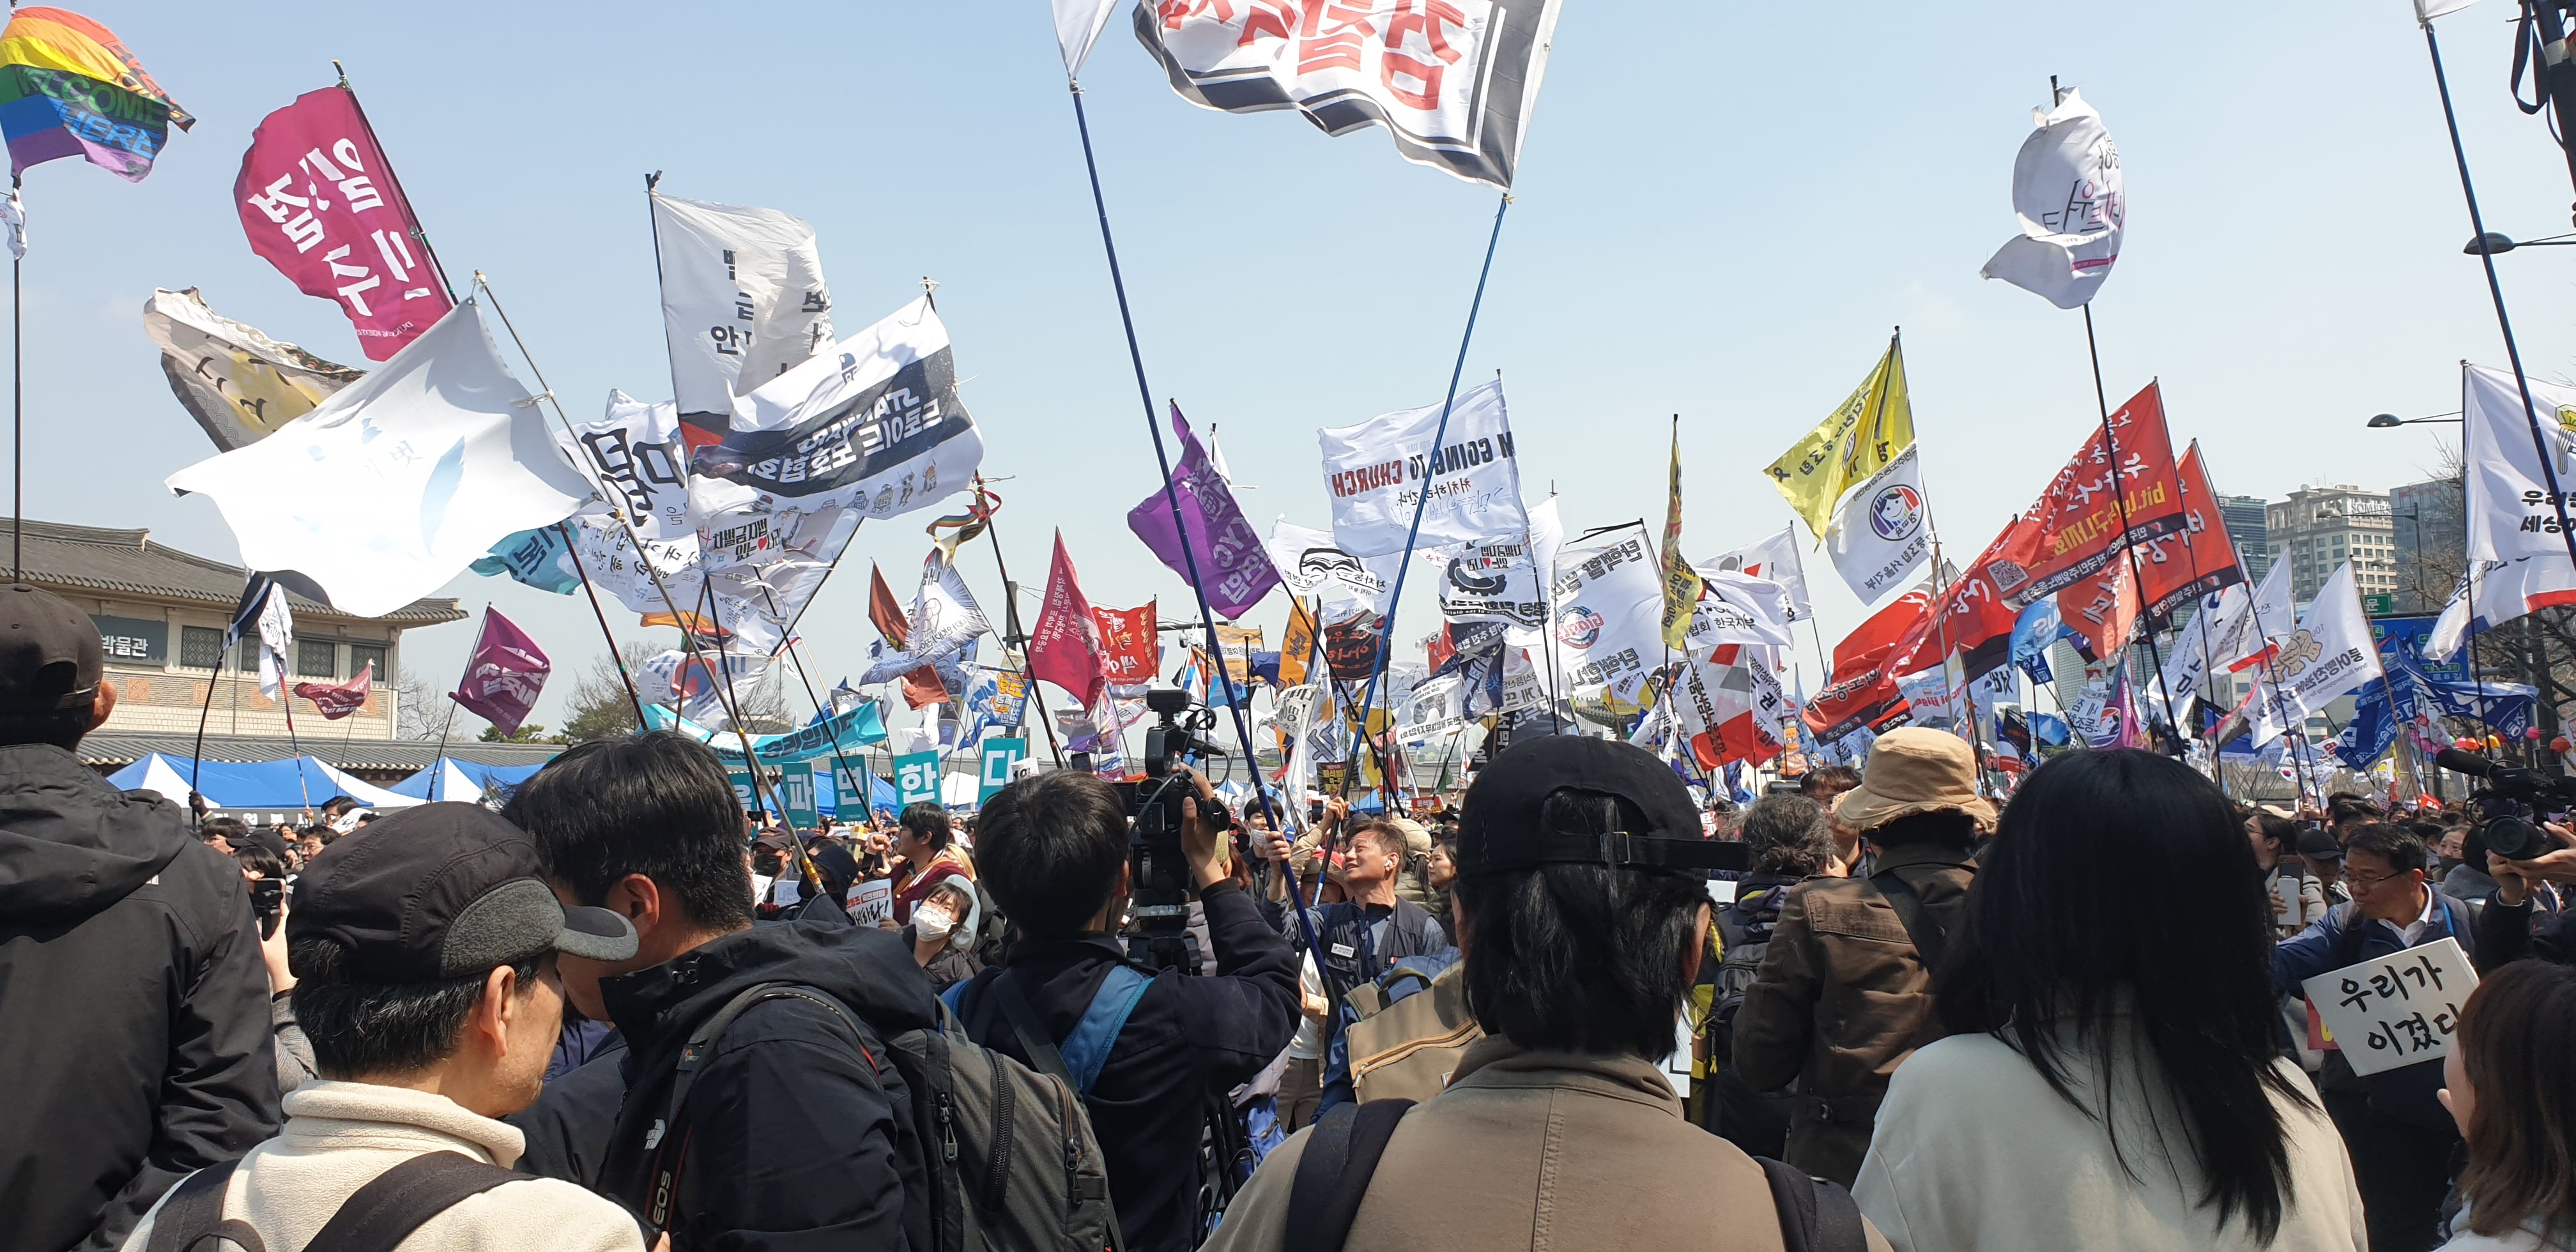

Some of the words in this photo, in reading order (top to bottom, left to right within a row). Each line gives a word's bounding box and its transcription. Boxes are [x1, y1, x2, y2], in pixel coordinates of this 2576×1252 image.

[712, 519, 767, 549] 차별금지법
[2339, 956, 2442, 1013] 우리가
[2368, 1004, 2458, 1057] 이겼다
[653, 1170, 671, 1225] EOS
